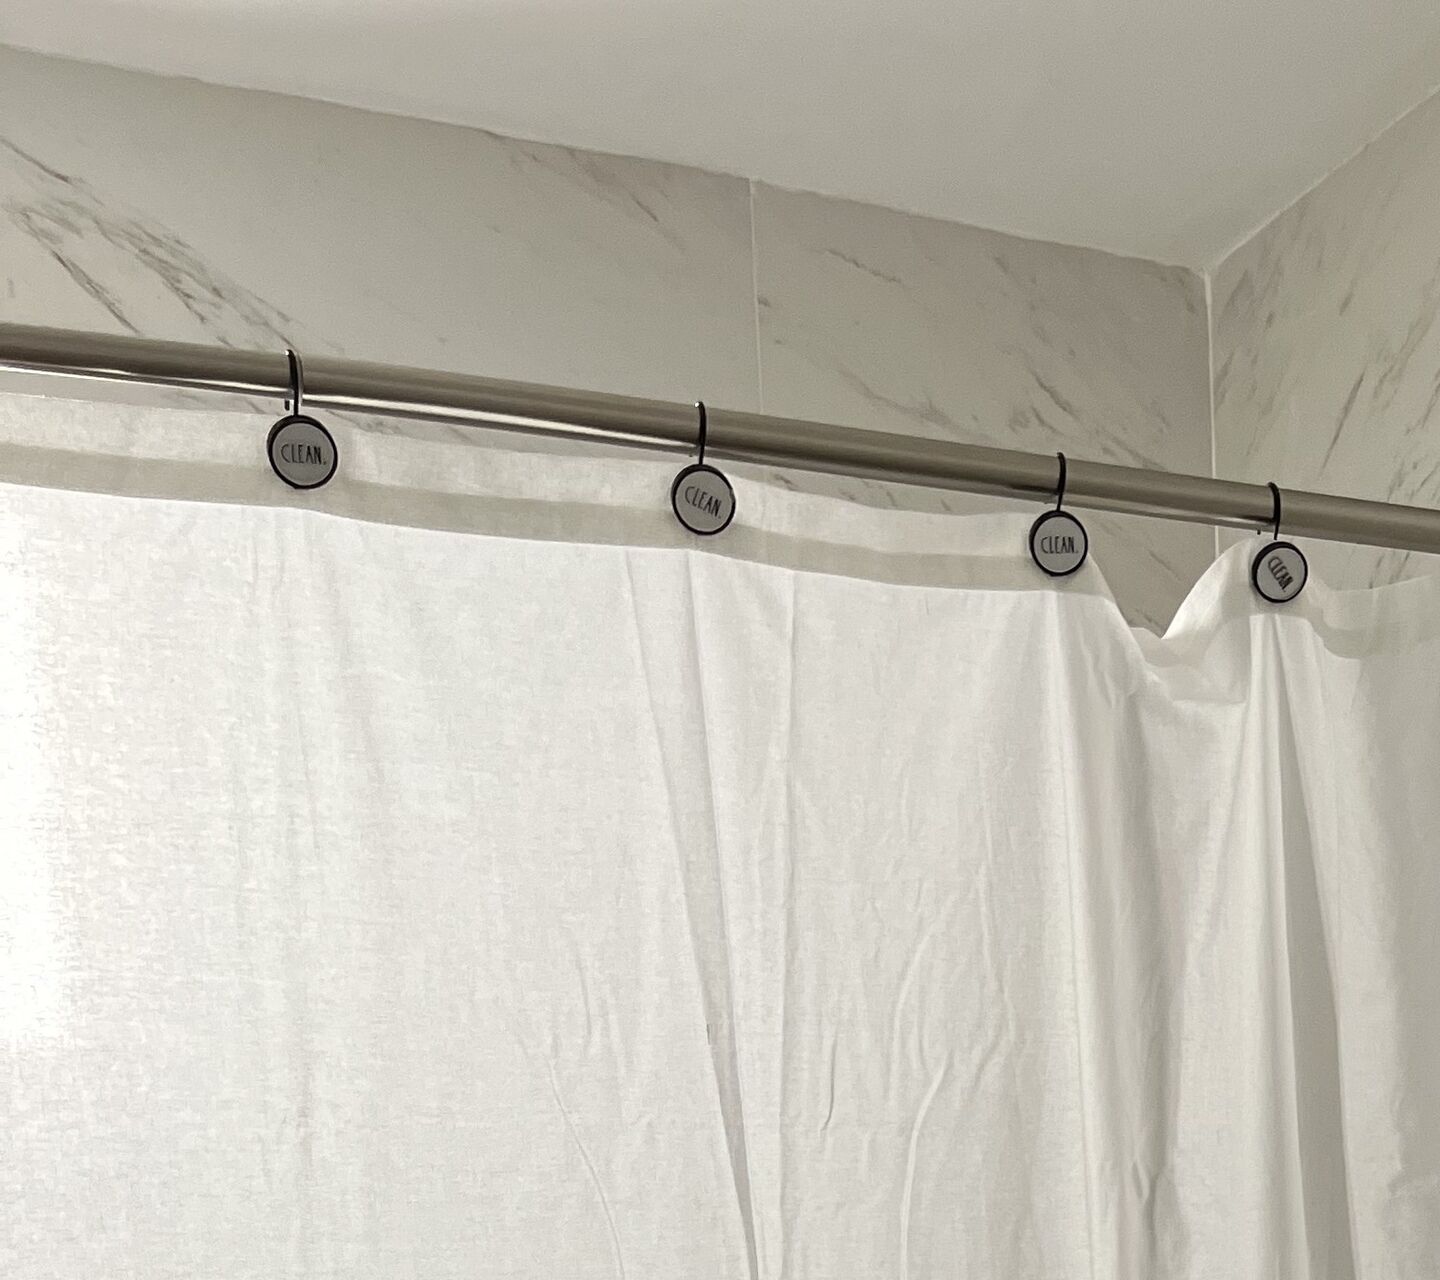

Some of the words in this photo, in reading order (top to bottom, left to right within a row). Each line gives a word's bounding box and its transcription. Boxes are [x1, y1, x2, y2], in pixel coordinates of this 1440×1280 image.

[280, 443, 328, 465] CLEAN.
[683, 485, 723, 519] CLEAN.
[1040, 534, 1079, 554] CLEAN.
